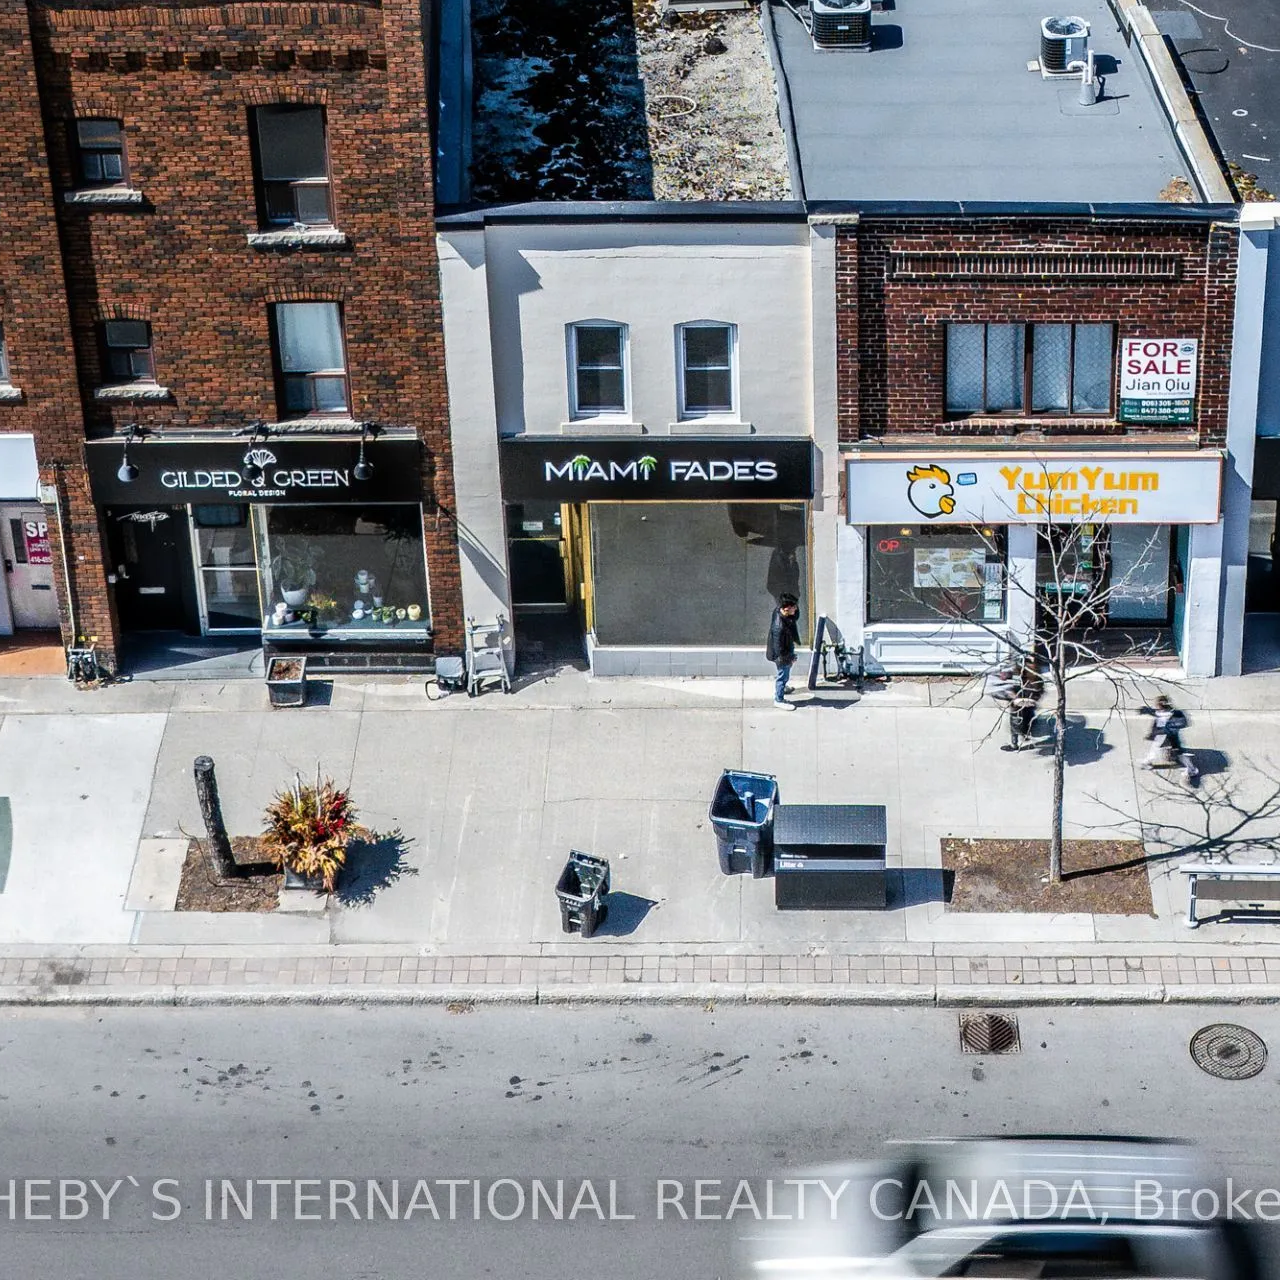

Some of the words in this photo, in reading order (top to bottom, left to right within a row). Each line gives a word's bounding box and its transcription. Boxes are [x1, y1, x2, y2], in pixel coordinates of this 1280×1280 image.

[1128, 342, 1178, 357] FOR
[1127, 359, 1191, 375] SALE
[1126, 378, 1160, 390] Jian
[1165, 378, 1190, 392] Qiu
[545, 455, 657, 481] MIAMI
[670, 461, 778, 482] FADES
[161, 470, 242, 488] GILDED
[273, 470, 350, 487] GREEN
[999, 466, 1160, 490] YumYum
[259, 489, 286, 497] DESIGN
[1016, 493, 1138, 515] Chicken
